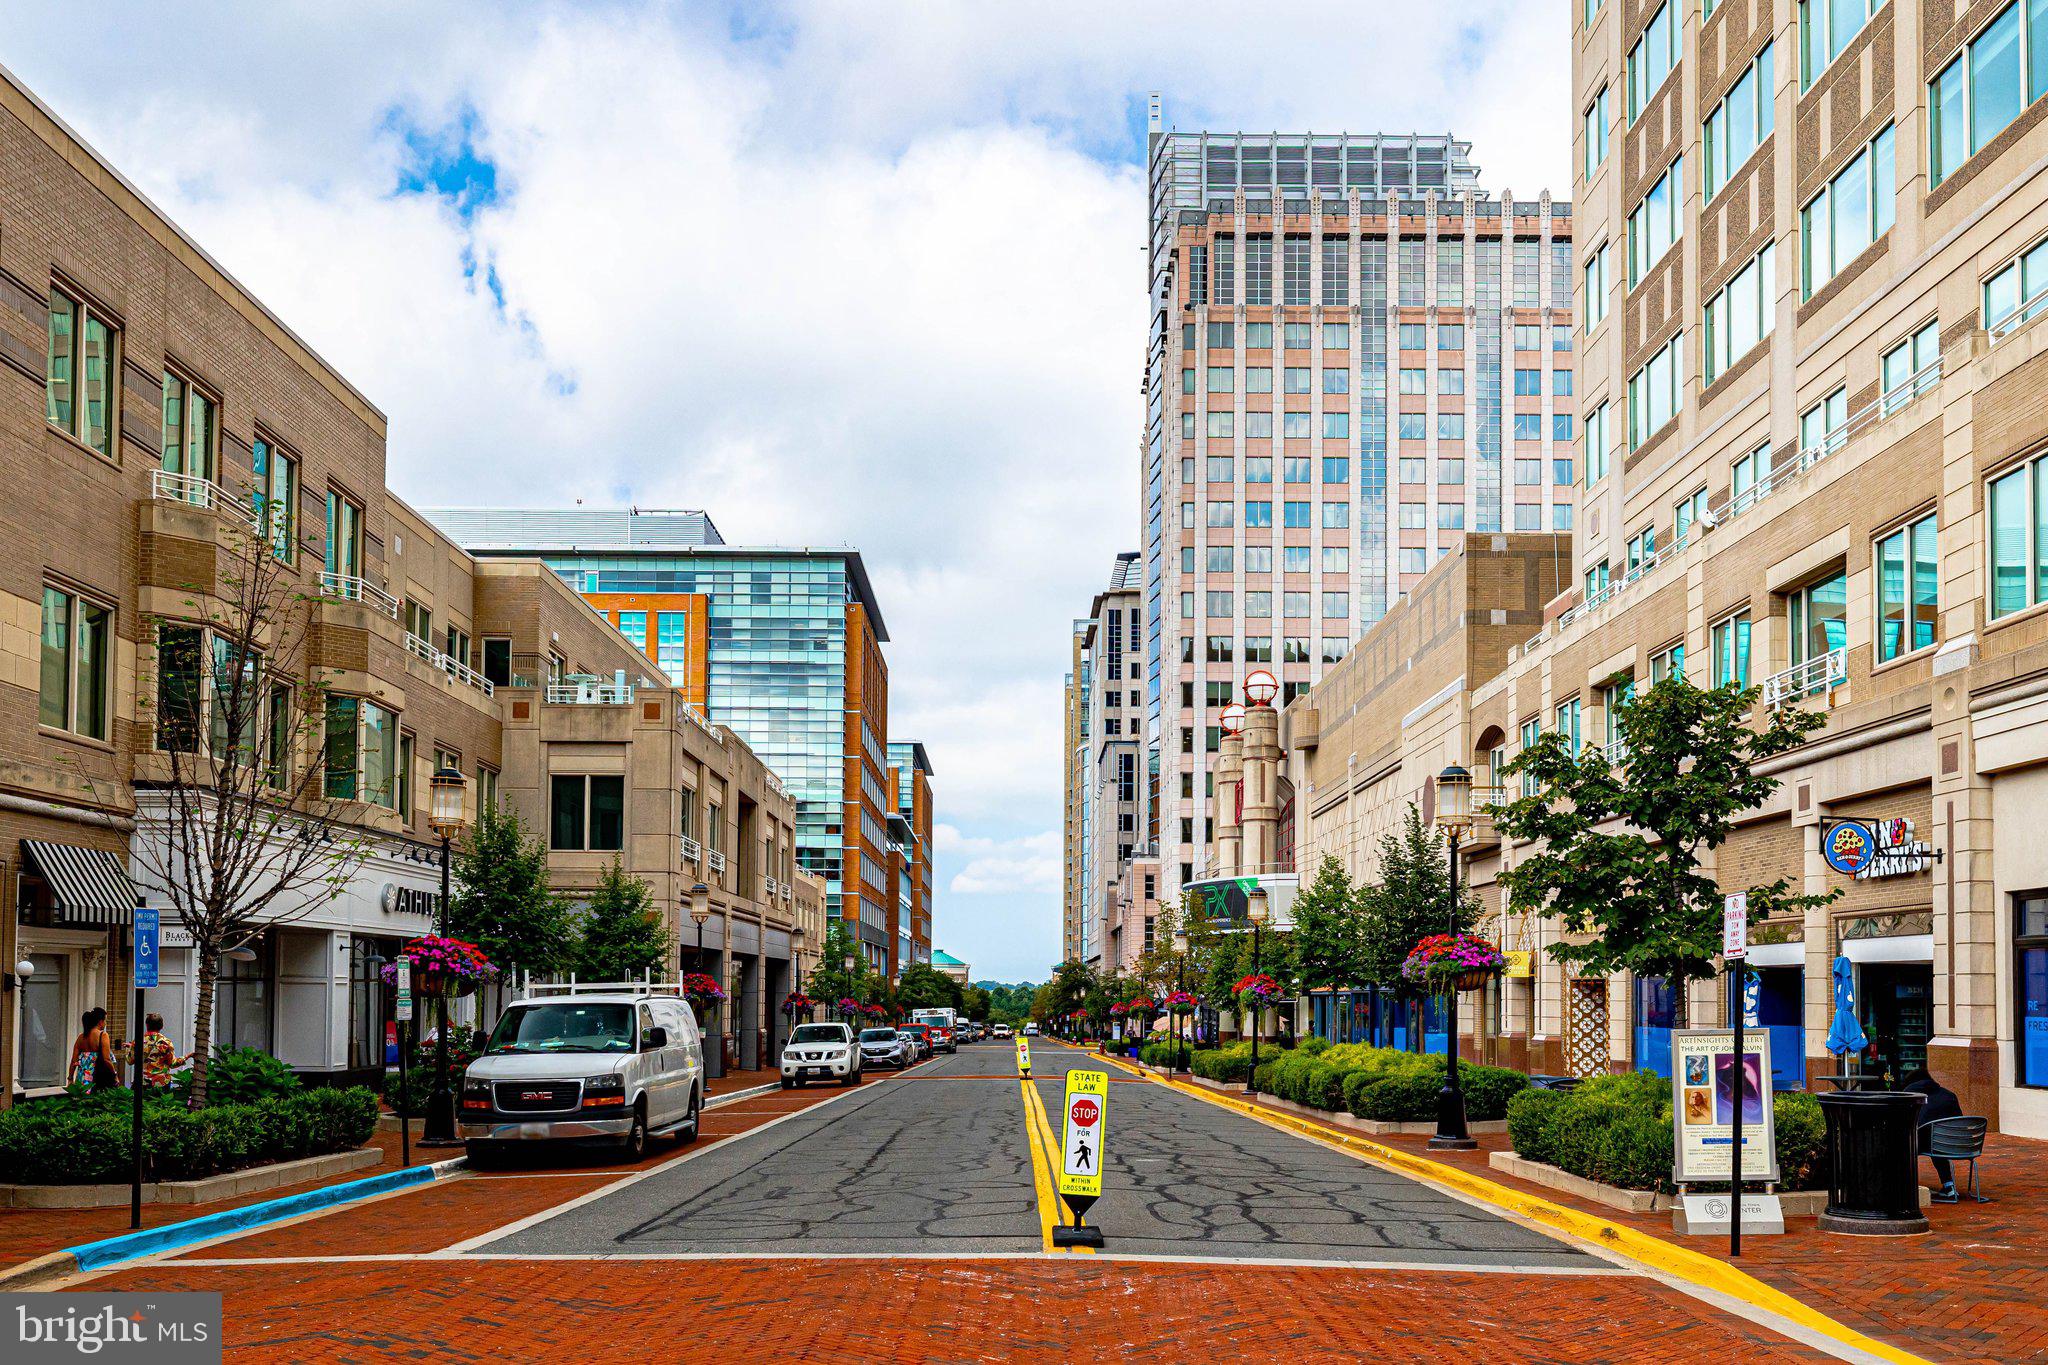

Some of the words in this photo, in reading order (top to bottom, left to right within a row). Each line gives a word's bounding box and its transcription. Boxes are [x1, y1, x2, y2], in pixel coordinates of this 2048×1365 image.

[1732, 899, 1739, 909] NO
[1726, 910, 1744, 920] PARKING
[1731, 921, 1739, 929] TOW
[165, 931, 190, 939] BLACK
[1730, 930, 1740, 938] AWAY
[1730, 938, 1740, 947] ZONE
[1074, 1073, 1101, 1083] STATE
[1077, 1083, 1096, 1091] LAW
[521, 1091, 553, 1100] GMC
[1072, 1107, 1098, 1119] STOP
[1076, 1129, 1091, 1137] FOR
[1071, 1177, 1091, 1185] WITHIN
[1062, 1184, 1098, 1193] CROSSWALK
